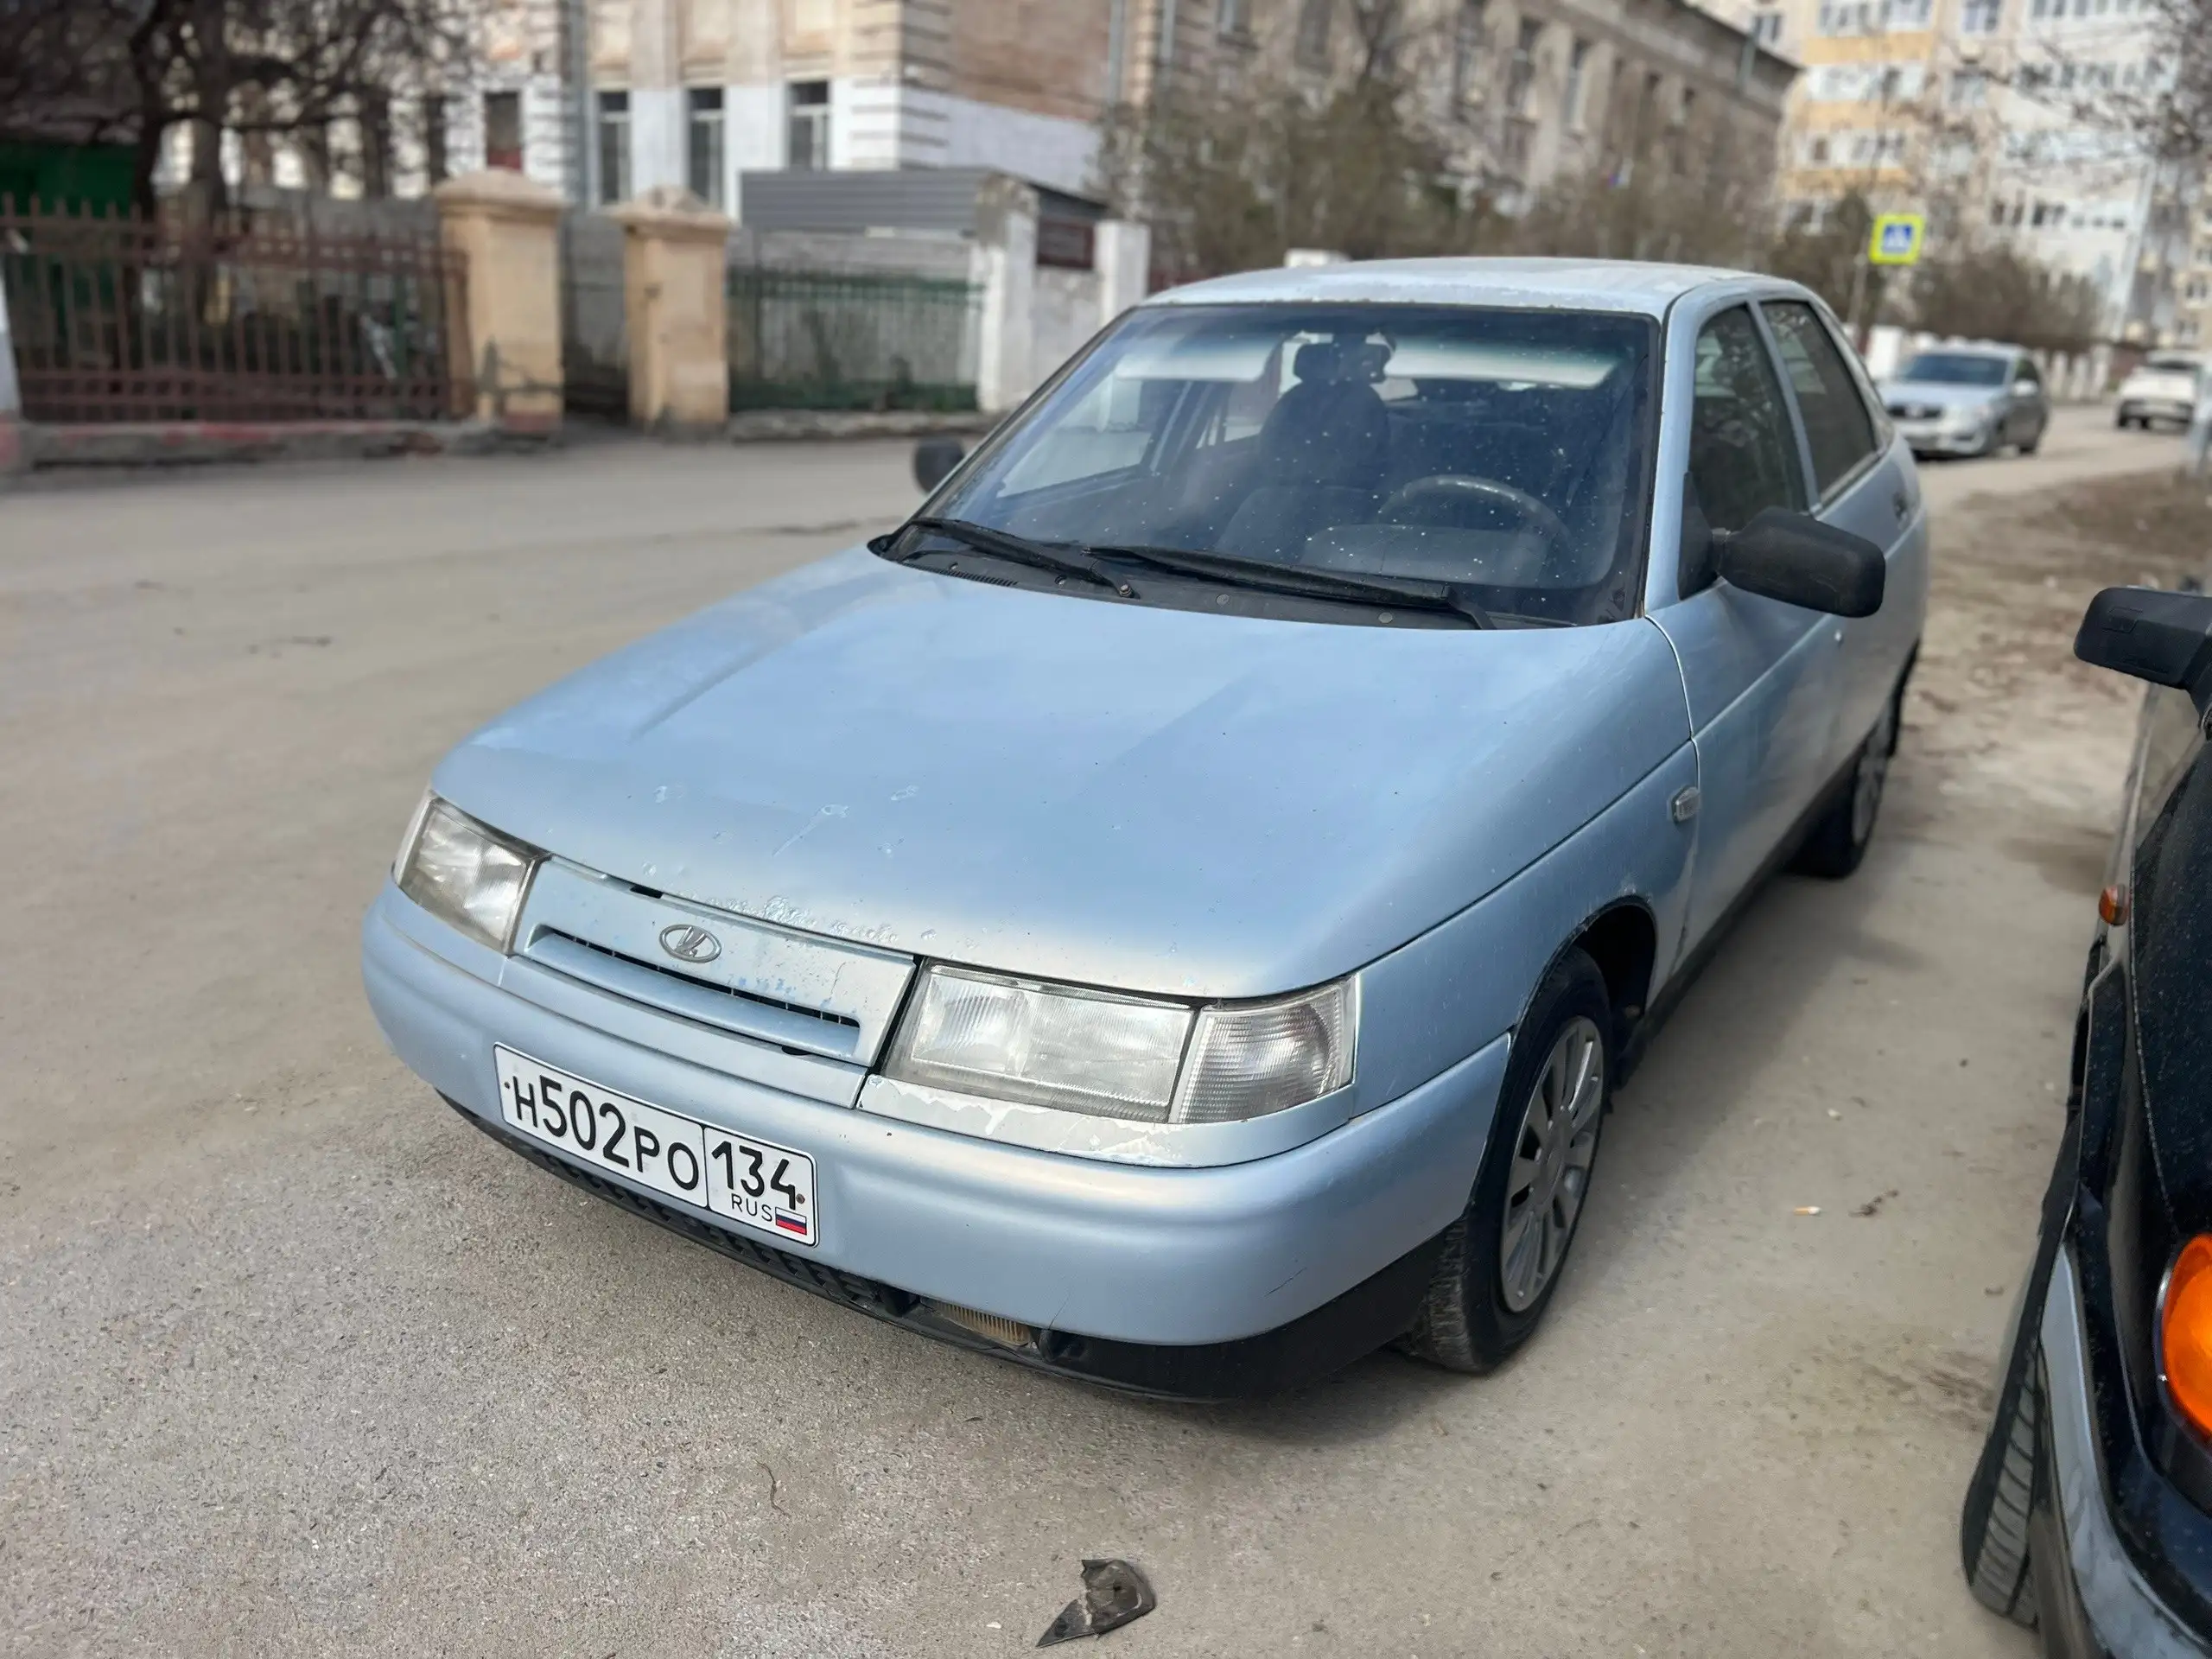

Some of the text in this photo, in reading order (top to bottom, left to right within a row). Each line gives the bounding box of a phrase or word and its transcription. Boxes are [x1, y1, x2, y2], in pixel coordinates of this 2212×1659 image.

[513, 1075, 796, 1210] Н502РО 134
[731, 1193, 773, 1222] RUS
